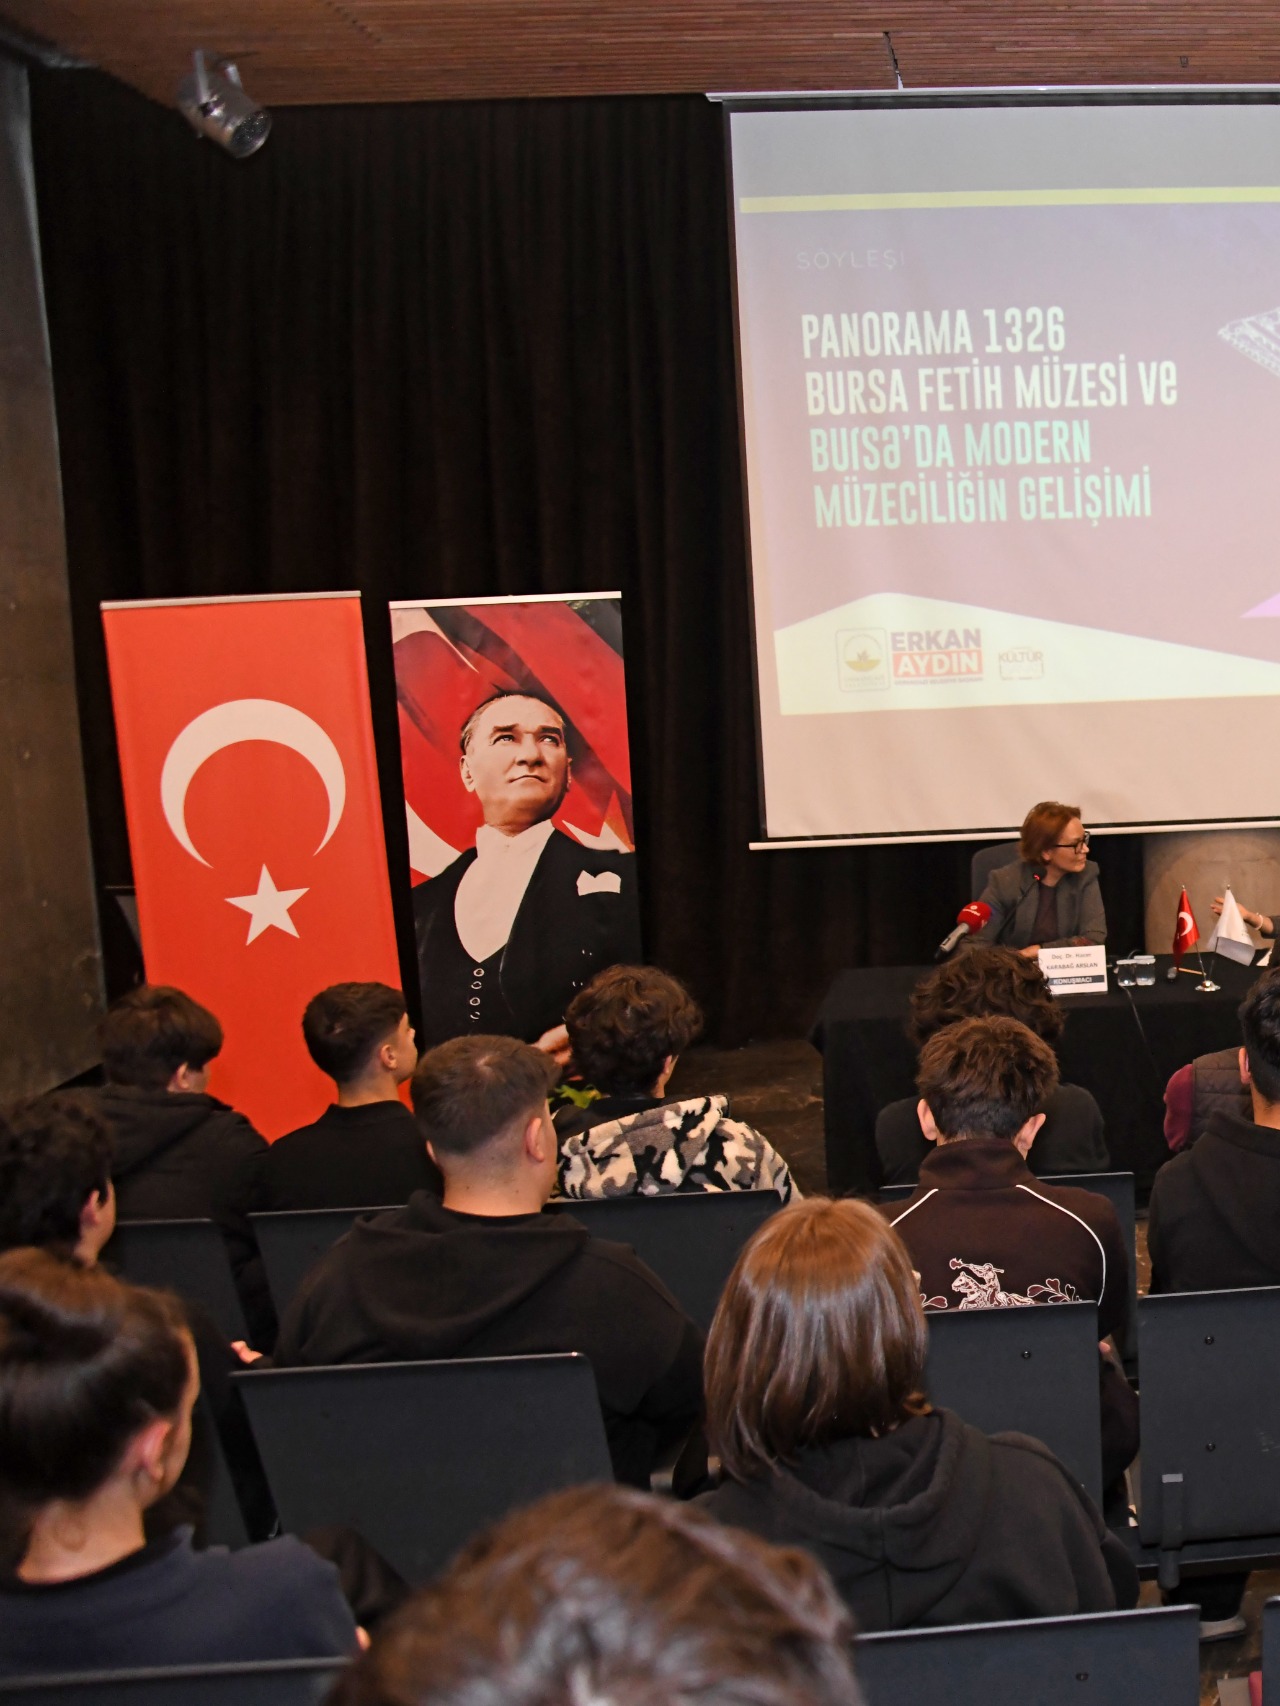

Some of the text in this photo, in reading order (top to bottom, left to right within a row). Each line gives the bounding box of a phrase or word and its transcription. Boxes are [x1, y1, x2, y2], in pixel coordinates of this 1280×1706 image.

[801, 306, 1066, 359] PANORAMA 1326
[805, 368, 910, 416] BURSA
[918, 357, 1002, 412] FETİH
[1014, 354, 1129, 408] MÜZESİ
[964, 419, 1091, 467] MODERN
[813, 466, 1152, 528] MÜZECİLİĞİN GELİŞİMİ
[890, 628, 982, 652] ERKAN
[898, 652, 979, 676] AYDIN
